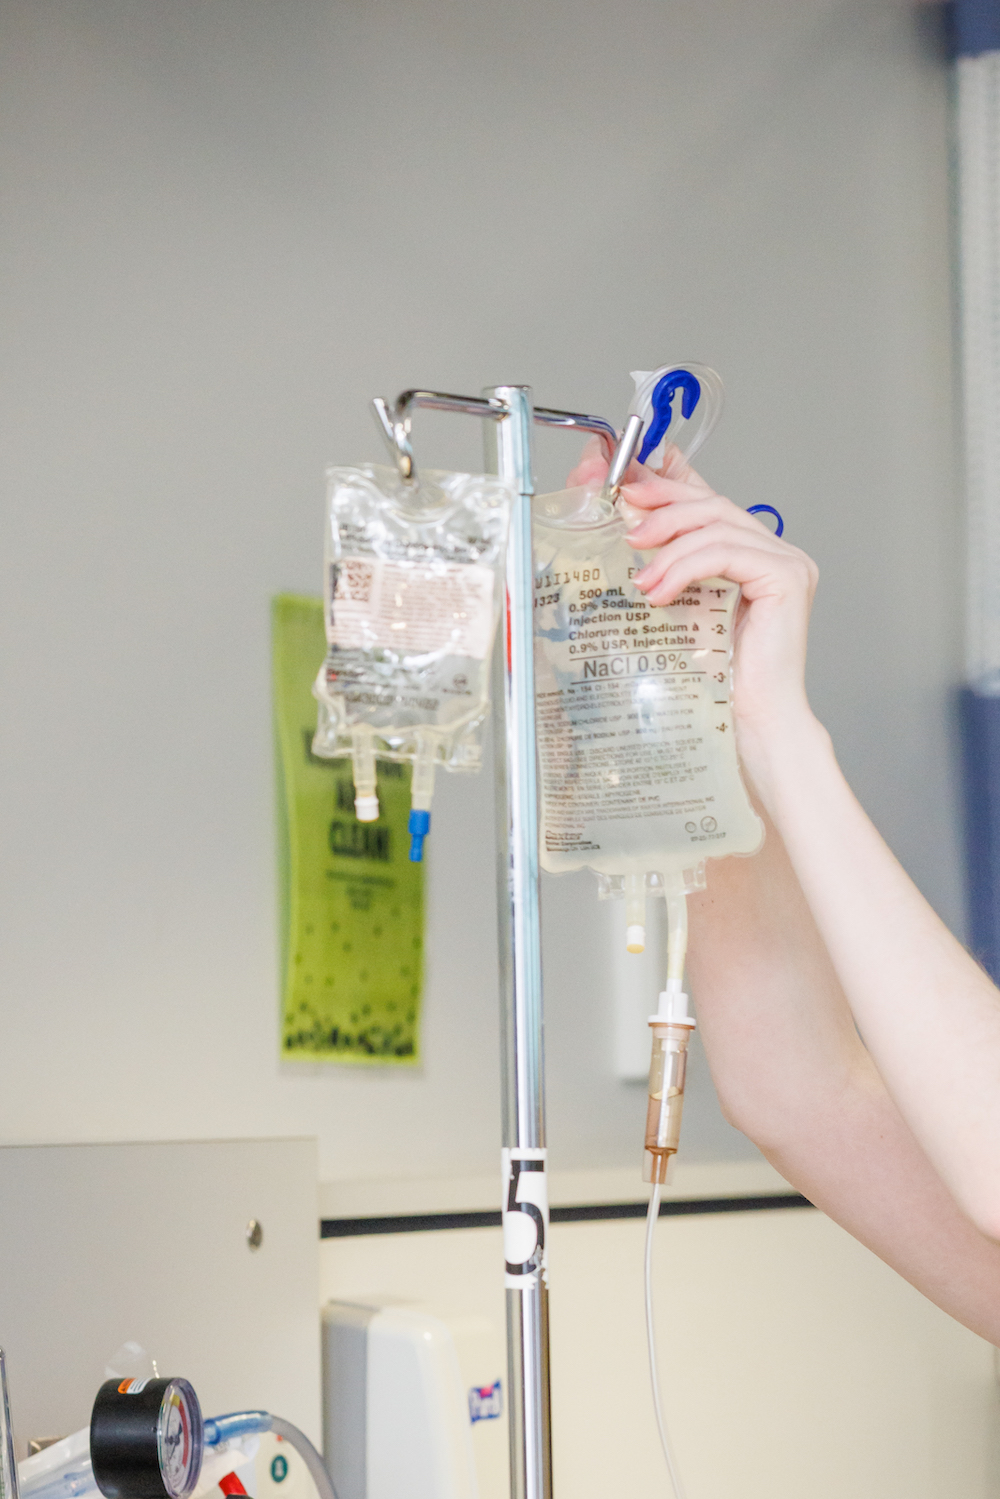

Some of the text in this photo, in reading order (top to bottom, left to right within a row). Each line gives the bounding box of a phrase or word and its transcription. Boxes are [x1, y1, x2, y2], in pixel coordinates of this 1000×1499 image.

[579, 586, 625, 600] 500 mL
[569, 602, 598, 613] 0.9%
[602, 599, 646, 610] Sodium
[569, 612, 650, 626] Injection USP
[569, 622, 700, 641] Chlorure de Sodium à
[569, 643, 598, 655] 0.9%
[633, 636, 696, 648] Injectable
[584, 653, 687, 679] NaCl 0.9%
[505, 1159, 545, 1275] 5
